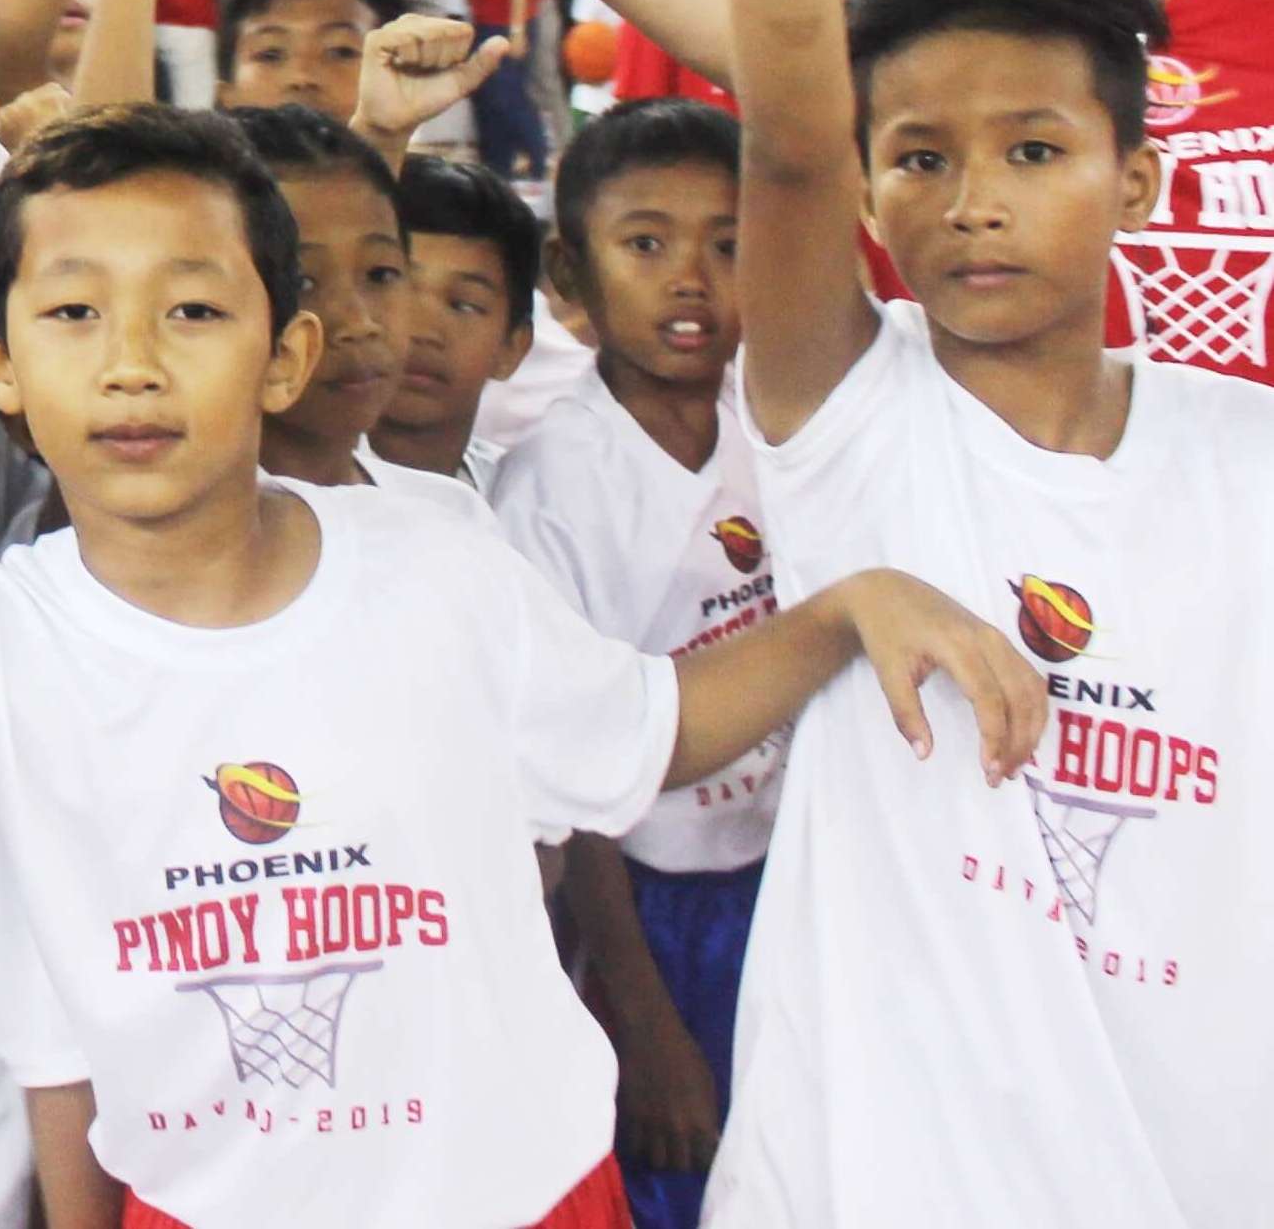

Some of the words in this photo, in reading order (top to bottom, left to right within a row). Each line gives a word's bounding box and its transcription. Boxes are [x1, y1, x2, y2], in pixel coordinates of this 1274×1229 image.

[1048, 671, 1156, 712] ENIX
[1054, 708, 1220, 805] HOOPS
[164, 843, 372, 890] PHOENIX
[113, 892, 261, 972] PINOY
[281, 883, 449, 962] HOOPS
